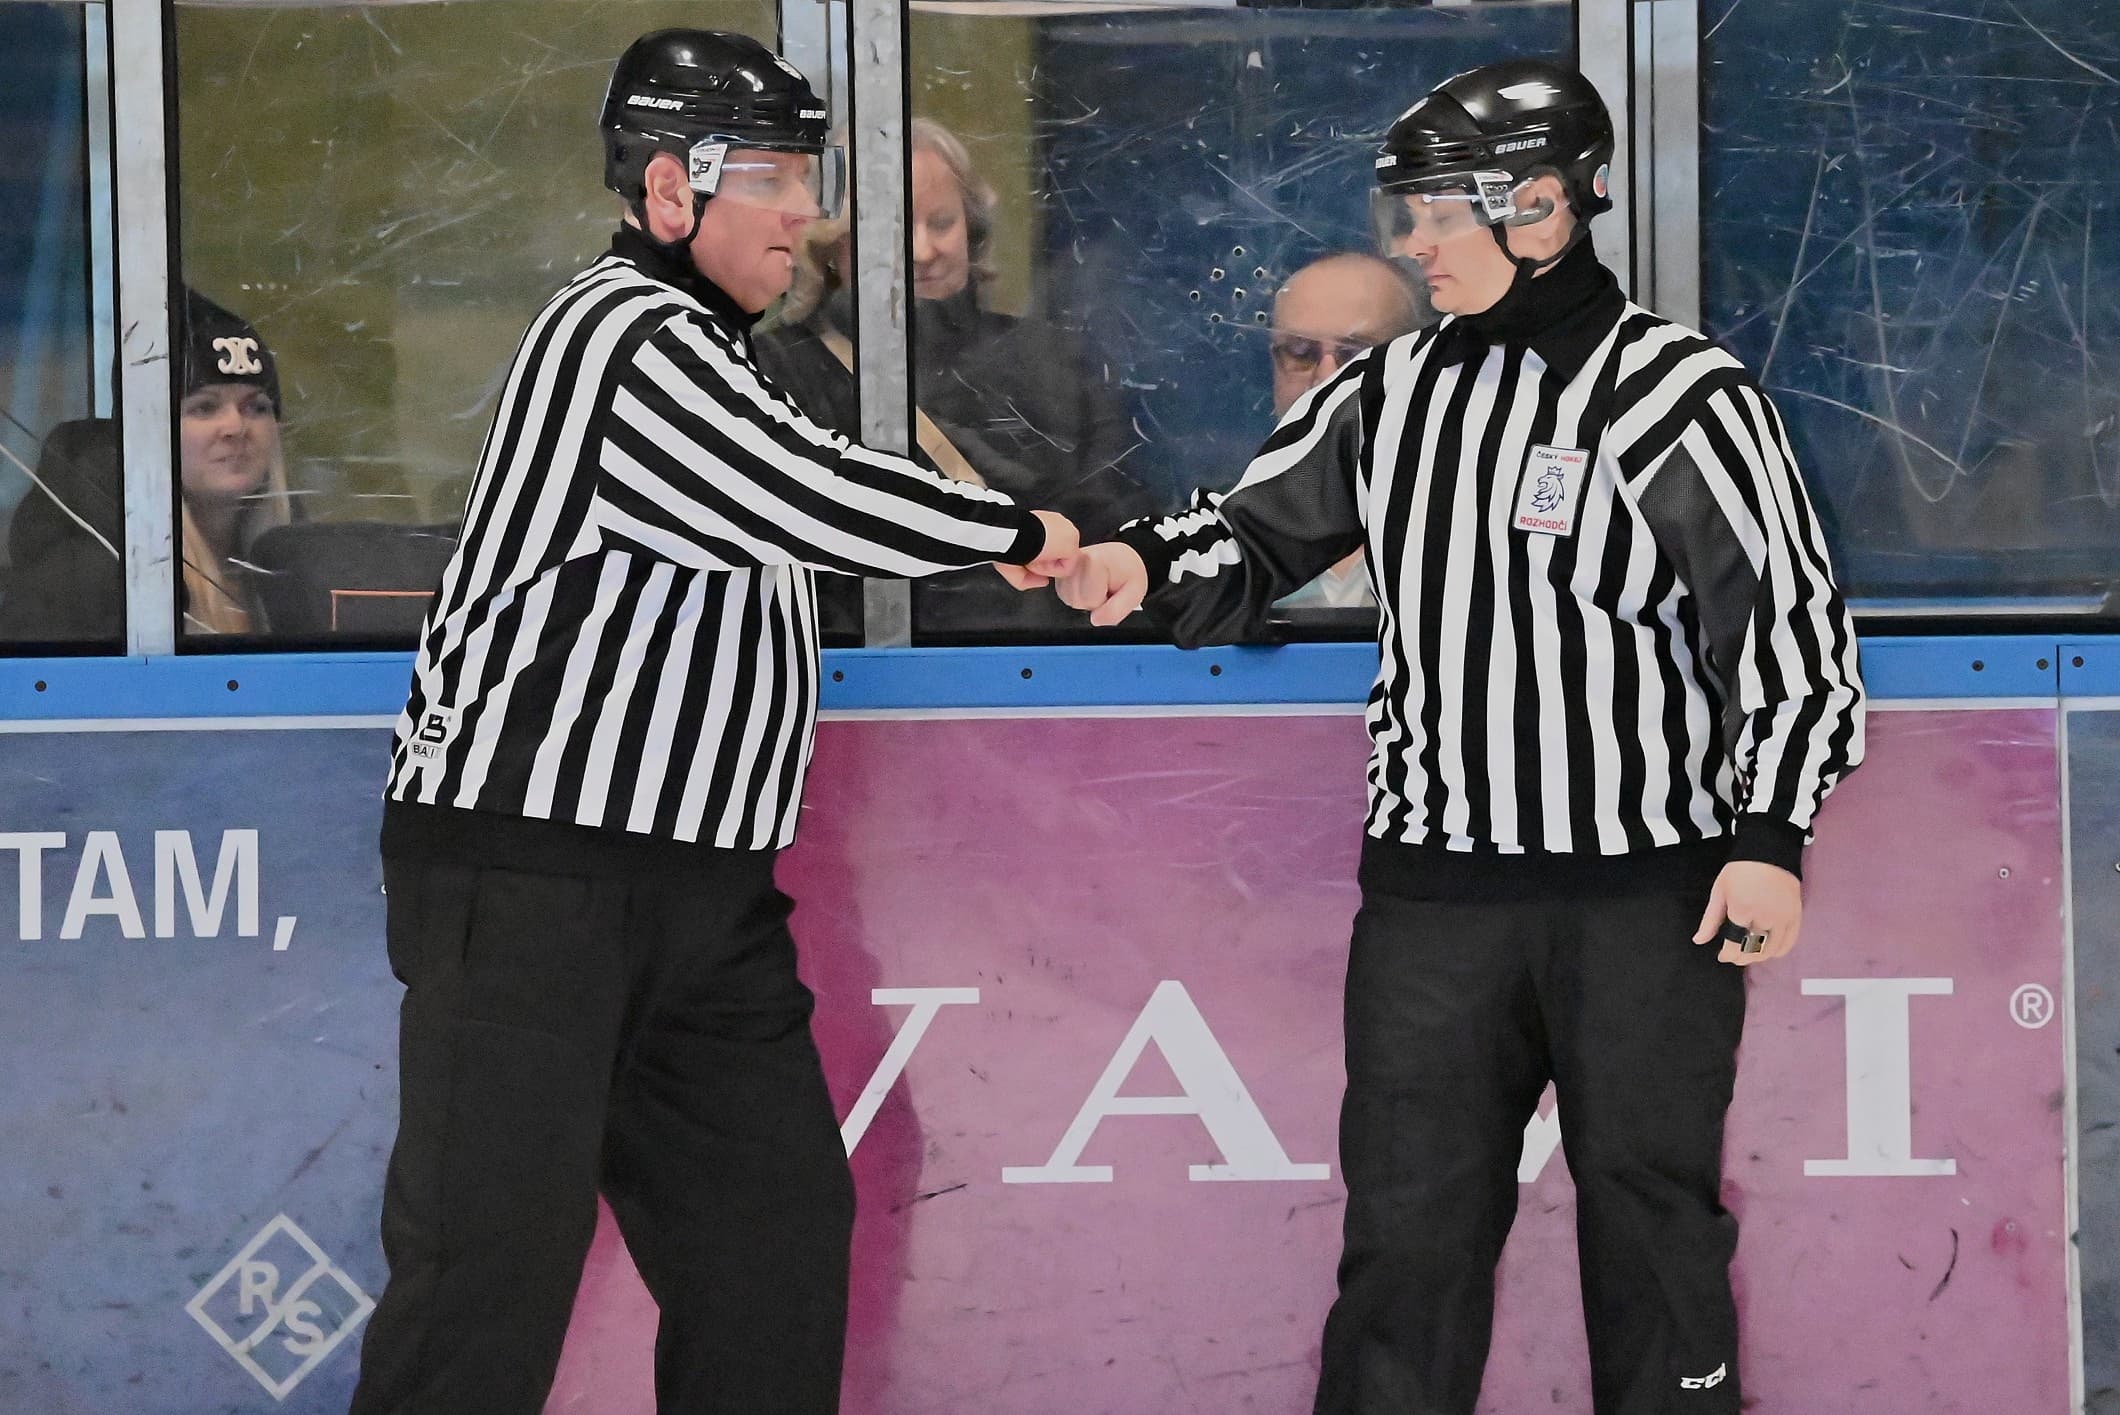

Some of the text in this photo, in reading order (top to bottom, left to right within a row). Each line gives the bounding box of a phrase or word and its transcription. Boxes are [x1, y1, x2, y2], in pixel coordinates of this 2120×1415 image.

[627, 94, 684, 111] BAUER
[1495, 137, 1547, 155] BAUER
[0, 829, 297, 951] TAM,
